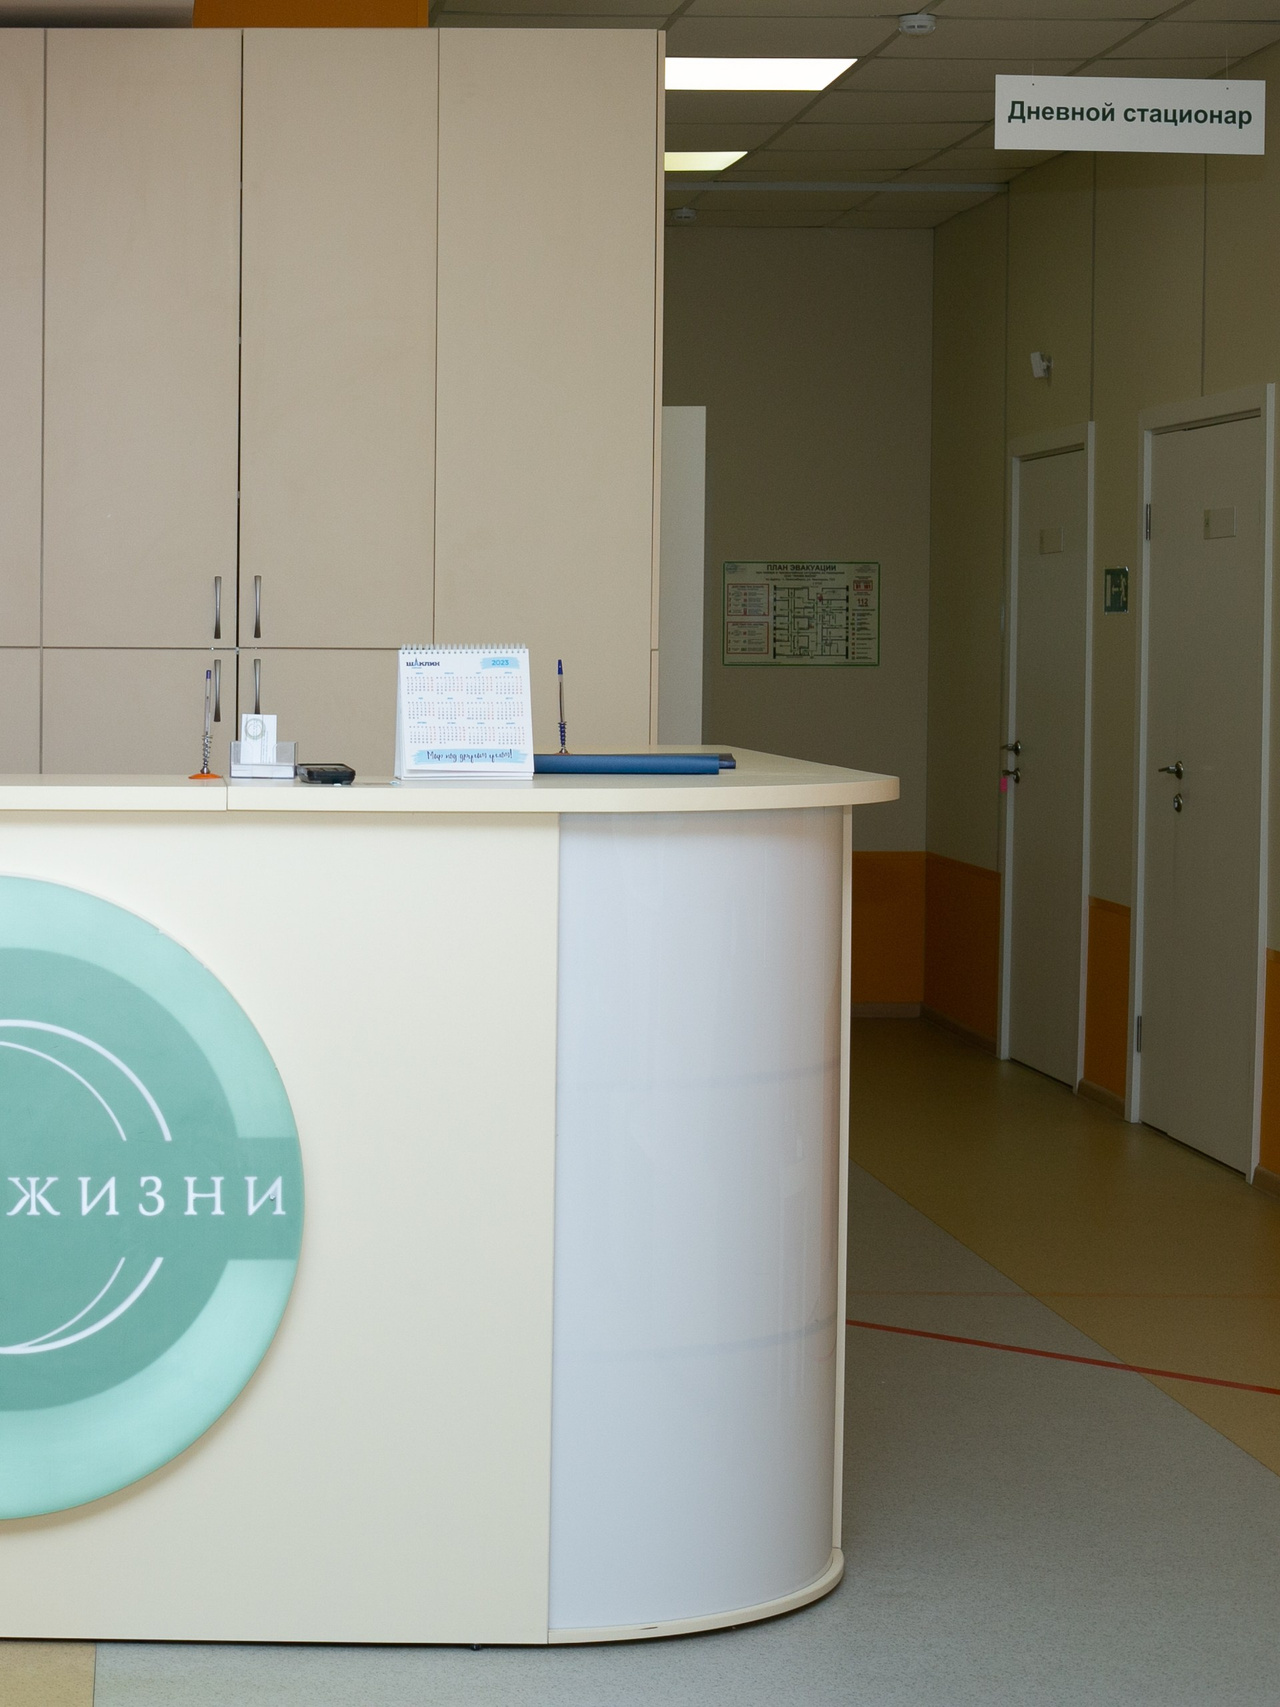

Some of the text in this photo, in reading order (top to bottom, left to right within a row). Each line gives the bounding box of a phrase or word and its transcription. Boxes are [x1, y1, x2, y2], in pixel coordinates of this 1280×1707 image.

[1008, 101, 1253, 129] Дневной стационар
[6, 1176, 287, 1217] ЖИЗНИ
